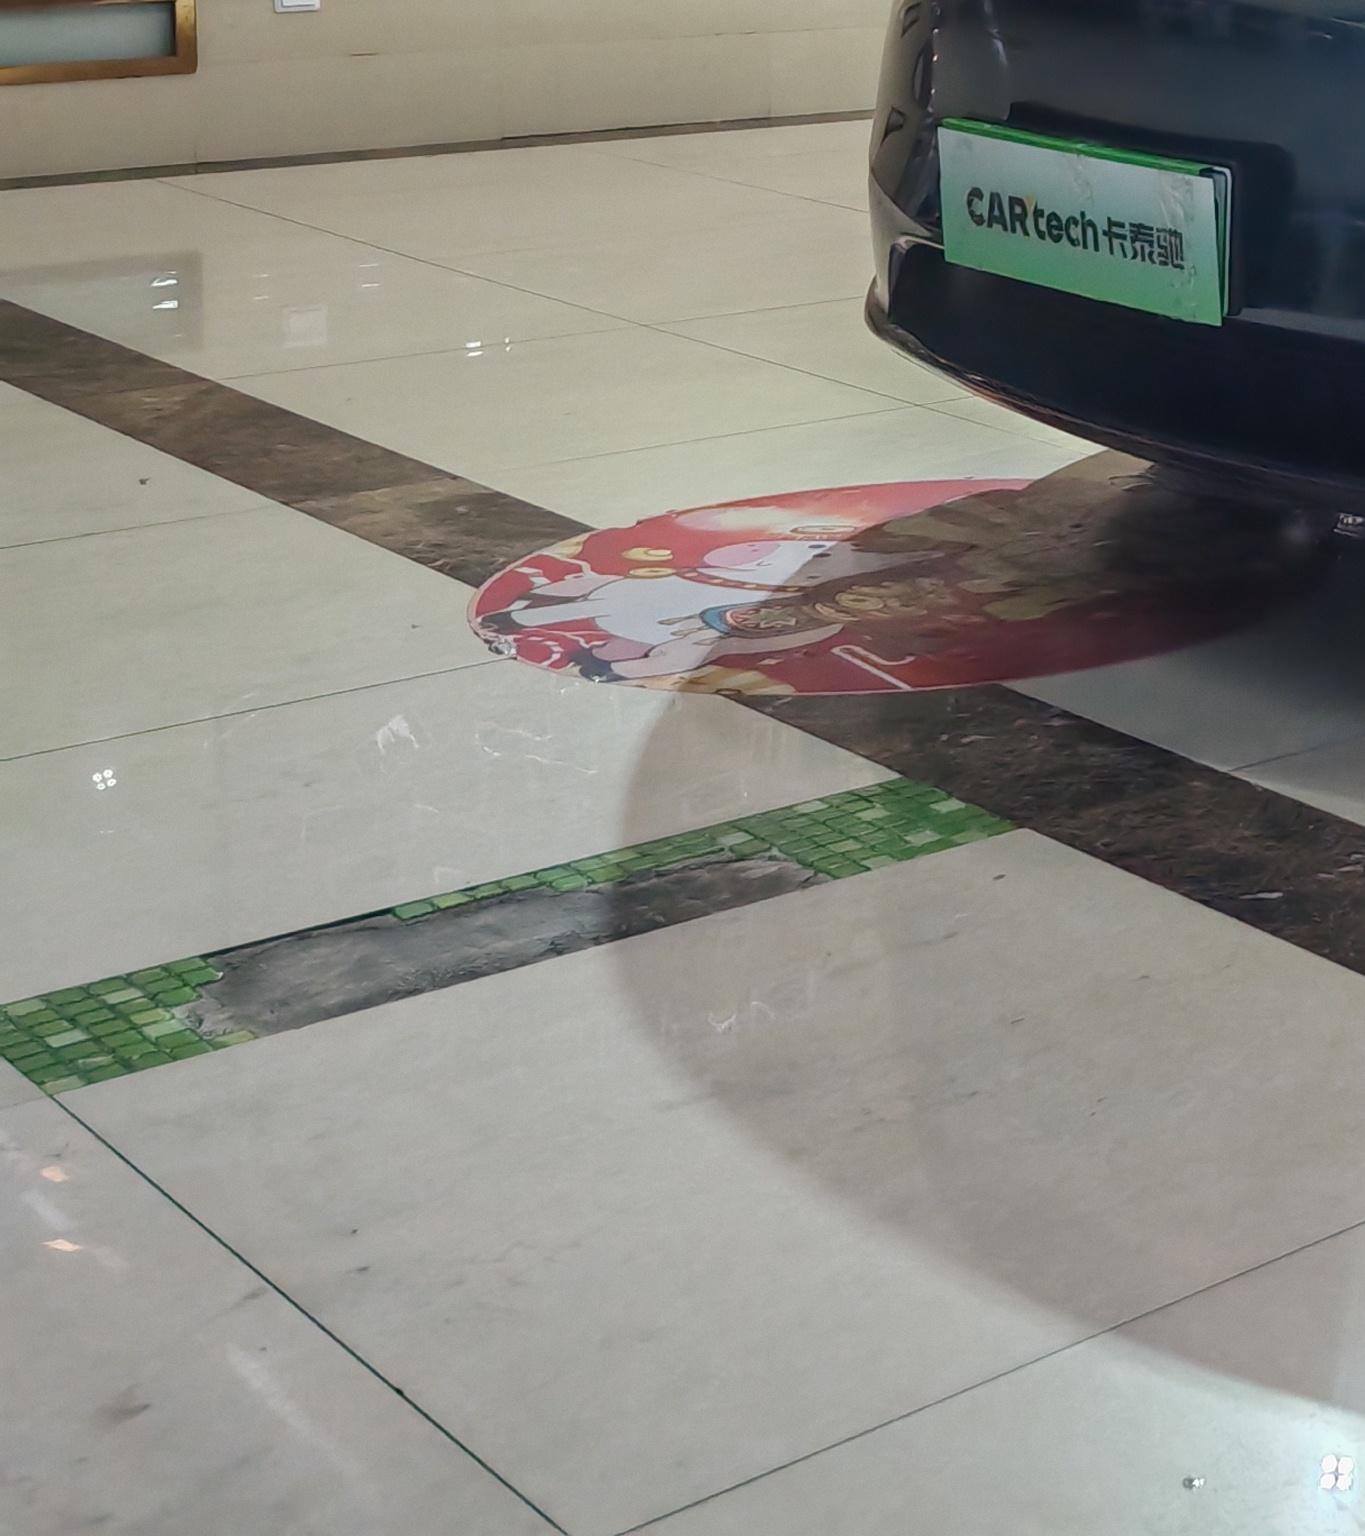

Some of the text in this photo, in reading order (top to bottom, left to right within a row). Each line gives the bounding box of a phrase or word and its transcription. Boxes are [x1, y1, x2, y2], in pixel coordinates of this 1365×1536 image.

[966, 187, 1185, 270] CARtech 卡泰驰
